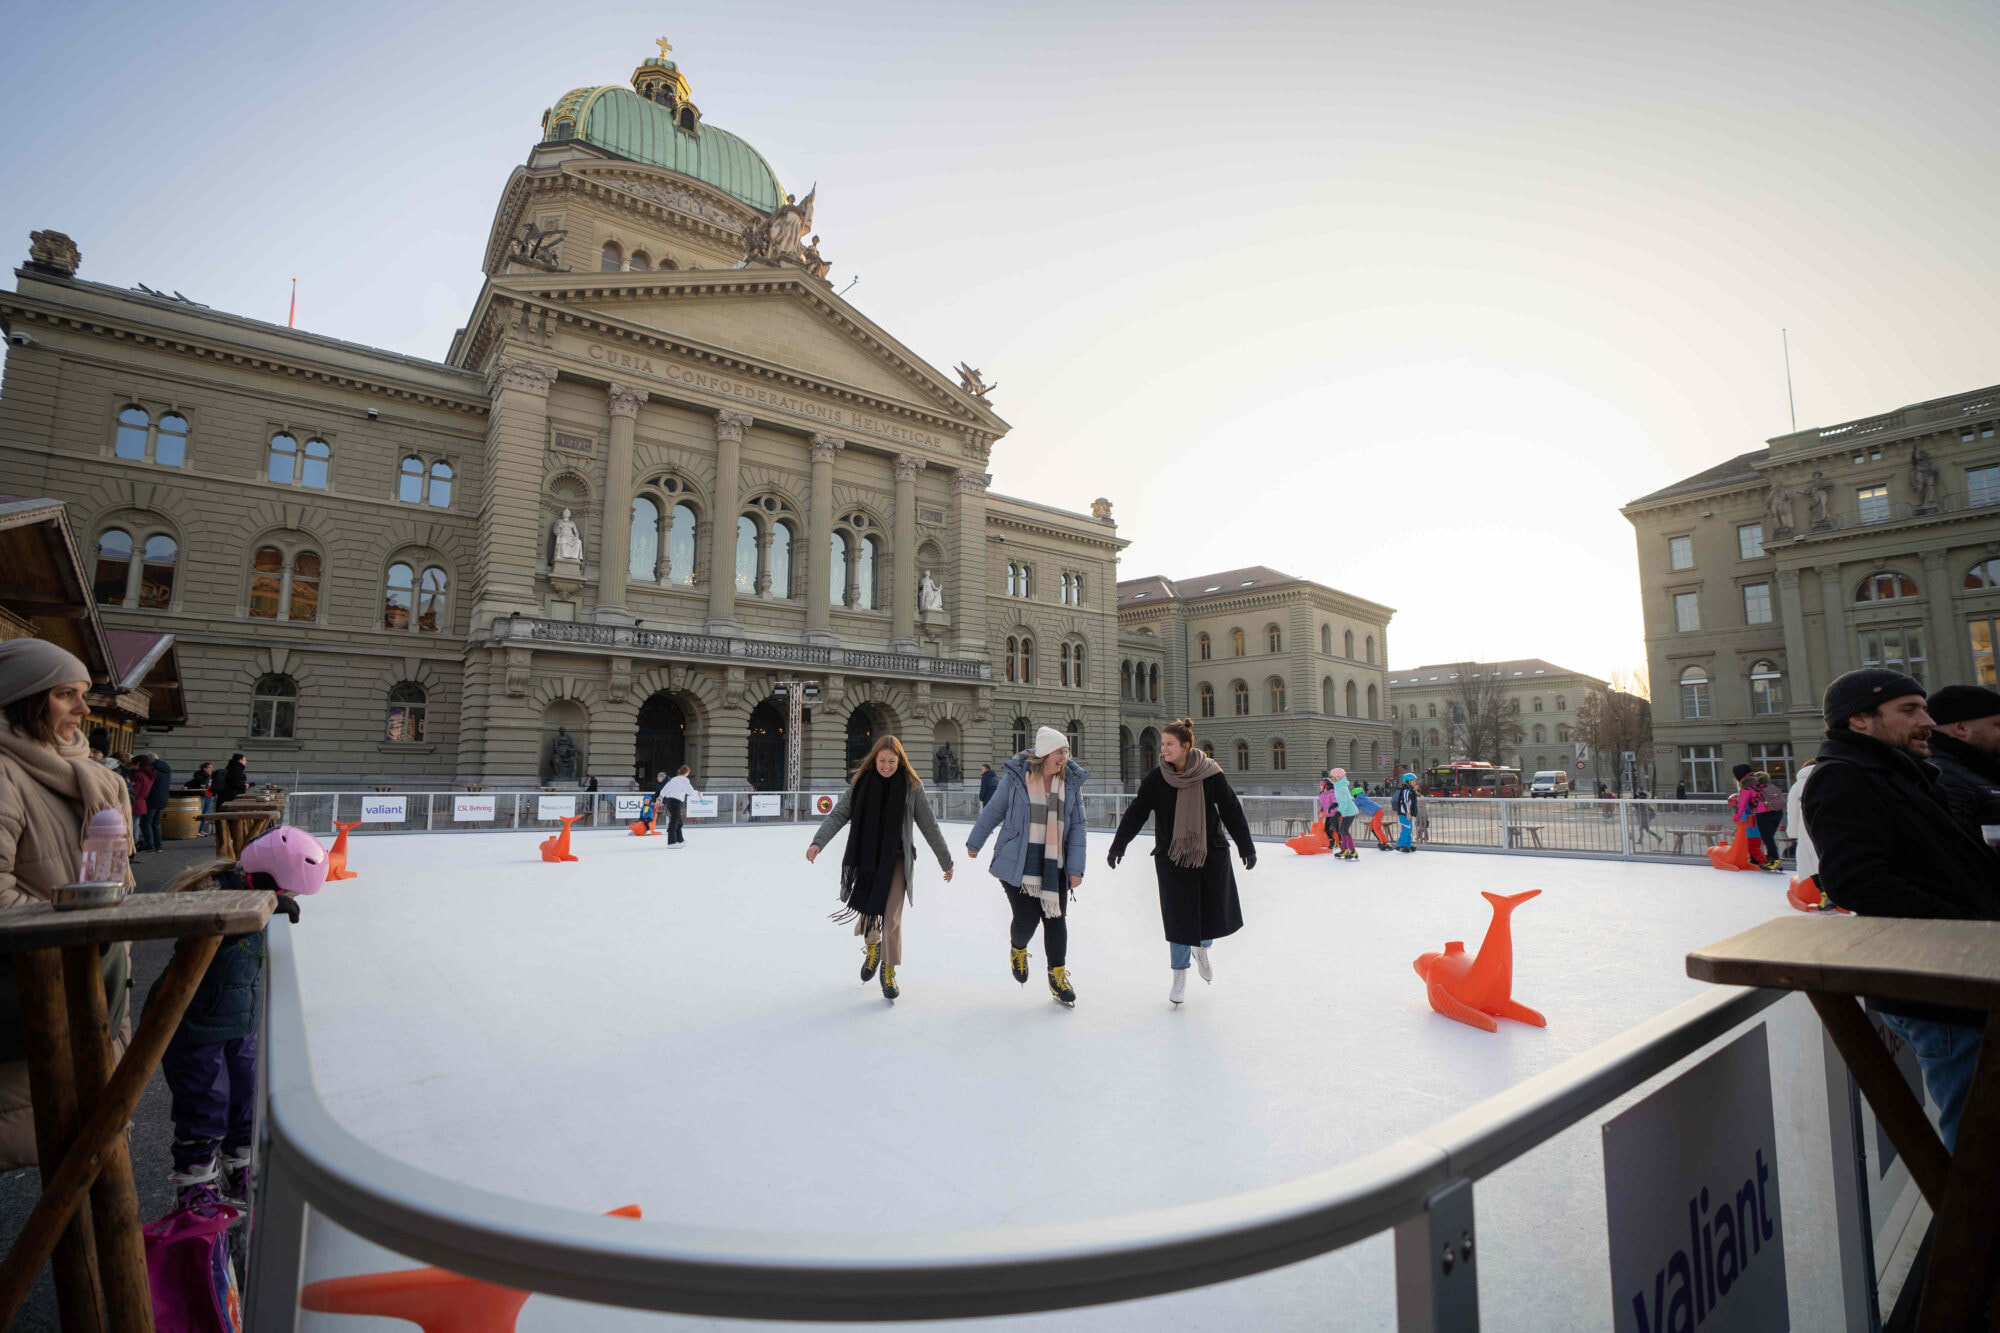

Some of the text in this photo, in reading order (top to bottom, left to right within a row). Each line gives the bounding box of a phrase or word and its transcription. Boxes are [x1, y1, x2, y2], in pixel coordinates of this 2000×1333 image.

[588, 343, 942, 448] CURIA CONFOEDERATIONIS HELVETICAE
[365, 804, 403, 814] valiant
[457, 804, 493, 813] CSL Behring
[1632, 1147, 1774, 1333] valiant
